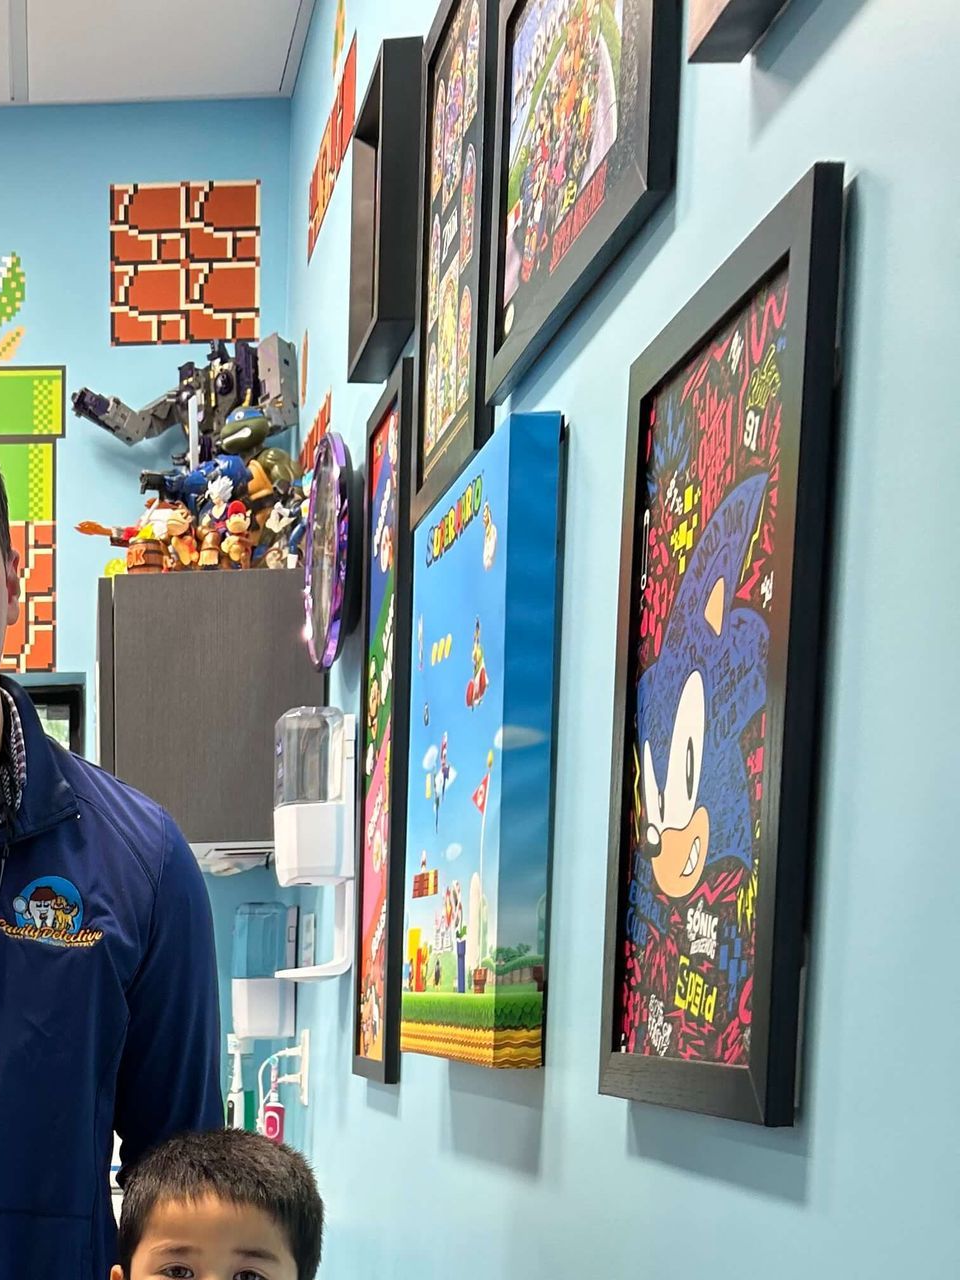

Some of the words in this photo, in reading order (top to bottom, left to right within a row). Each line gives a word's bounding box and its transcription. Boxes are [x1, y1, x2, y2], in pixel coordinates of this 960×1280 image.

[743, 410, 760, 452] 91
[425, 506, 455, 567] SUPER
[455, 474, 484, 541] MARIO
[41, 927, 103, 943] Detective
[686, 903, 719, 941] SONIC
